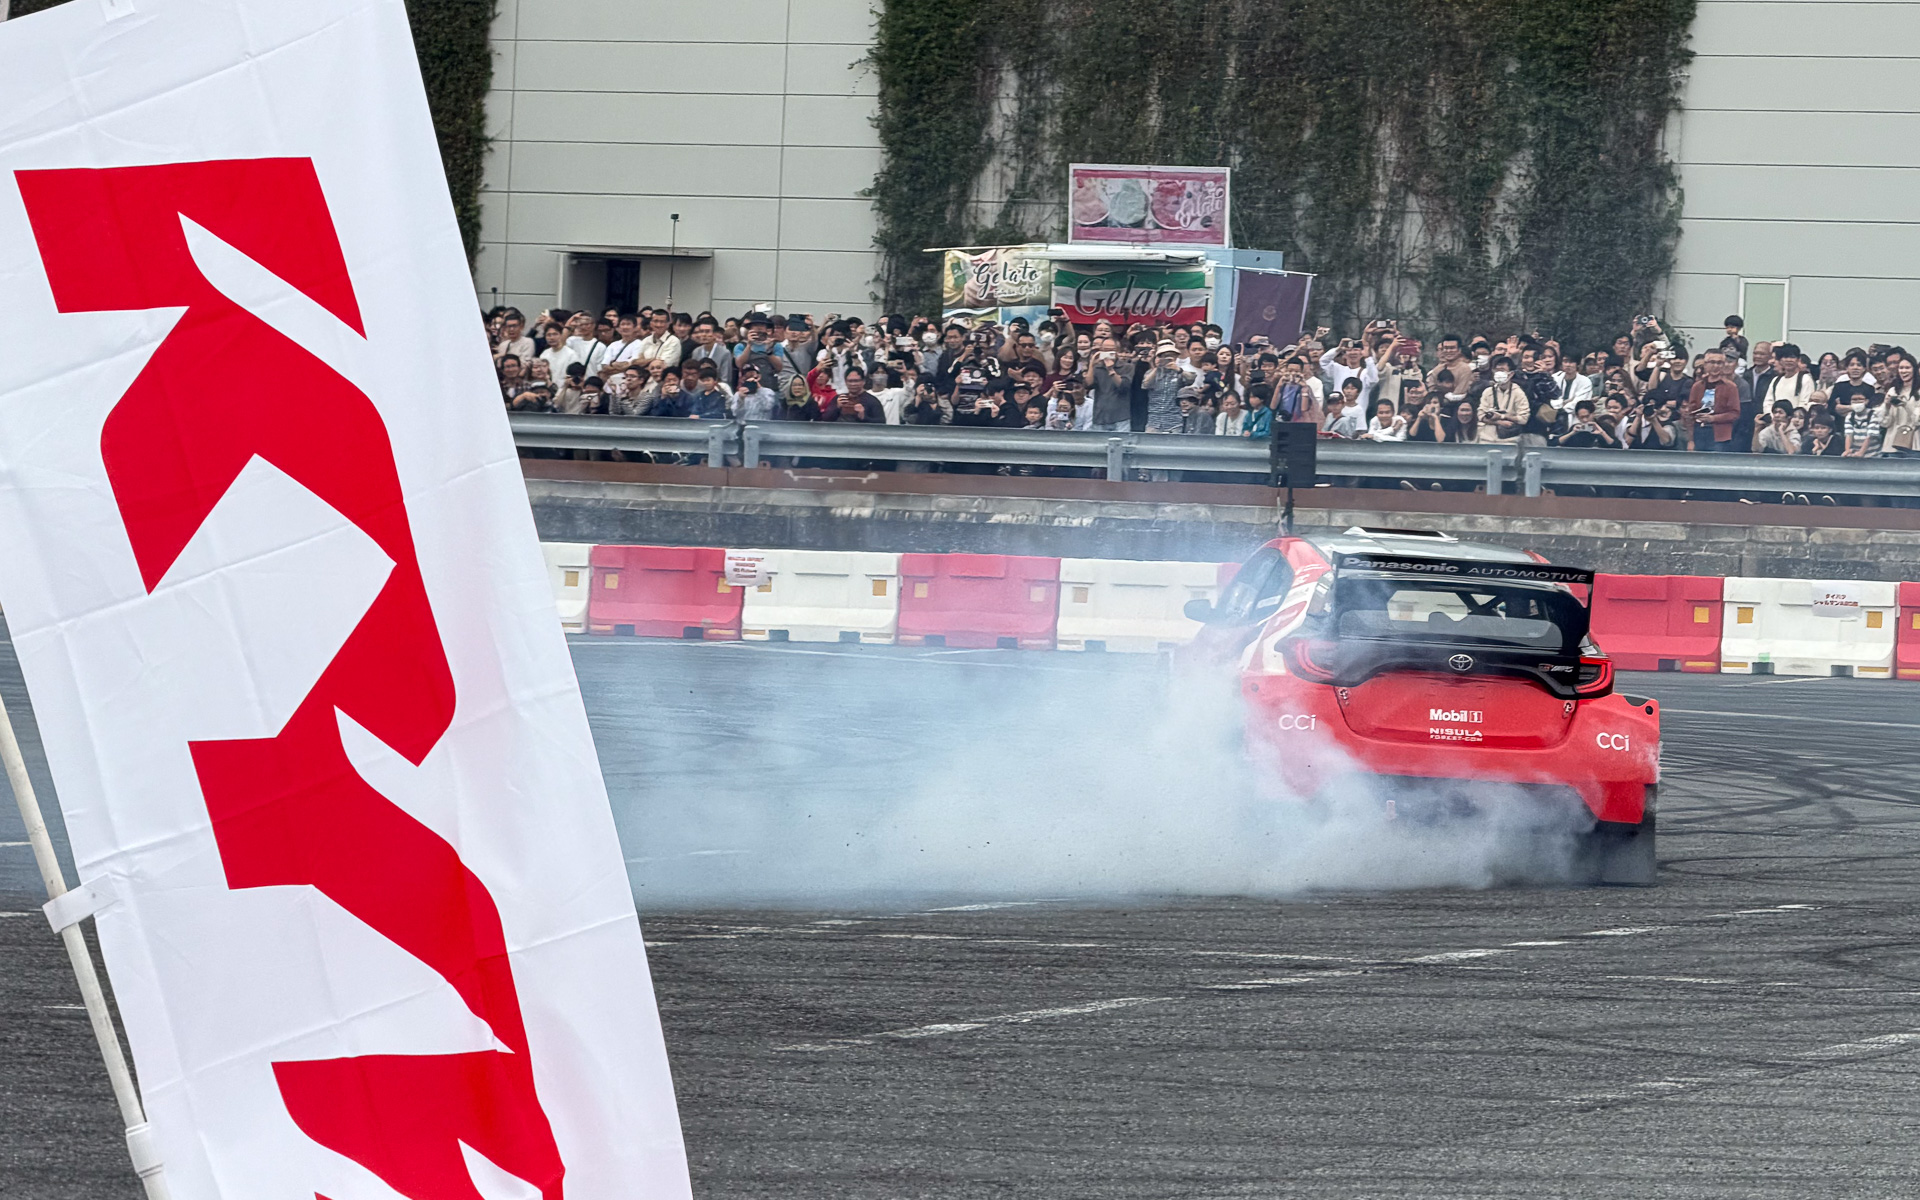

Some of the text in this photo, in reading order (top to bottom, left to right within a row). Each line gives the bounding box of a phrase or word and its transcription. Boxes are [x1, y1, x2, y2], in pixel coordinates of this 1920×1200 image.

[1074, 274, 1183, 317] Gelato
[1342, 557, 1588, 582] Panasonic AUTOMOTIVE
[1429, 708, 1468, 722] Mobil
[1429, 727, 1483, 737] NISULA
